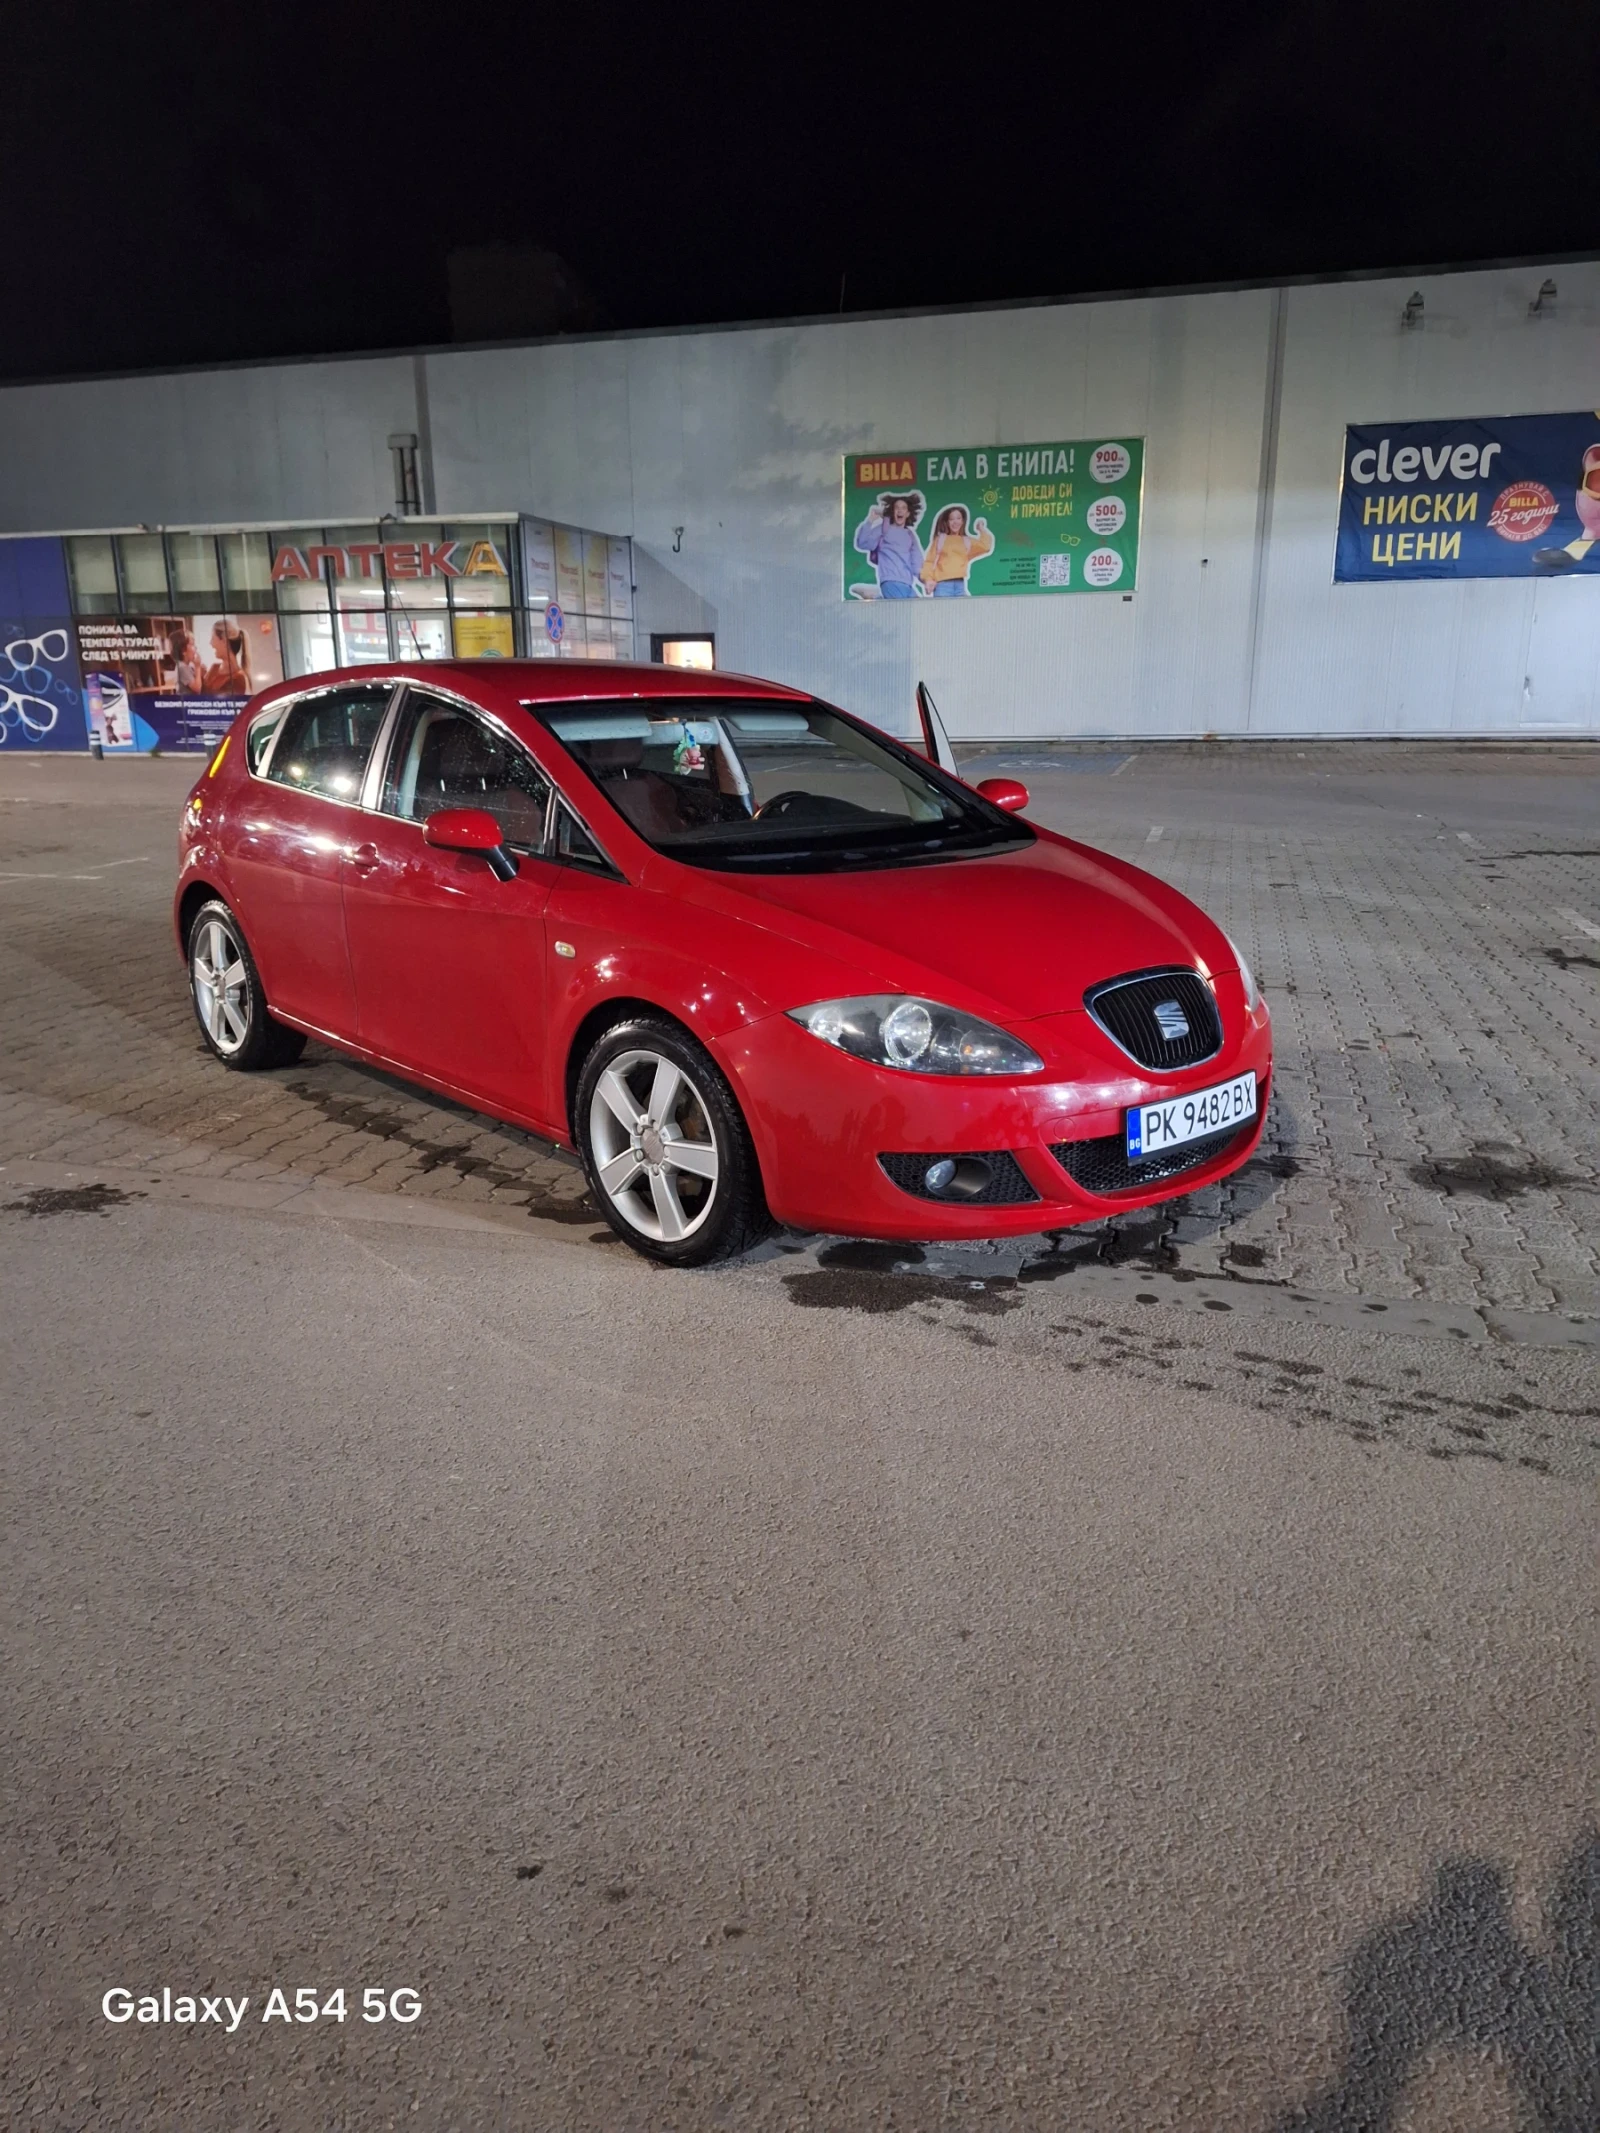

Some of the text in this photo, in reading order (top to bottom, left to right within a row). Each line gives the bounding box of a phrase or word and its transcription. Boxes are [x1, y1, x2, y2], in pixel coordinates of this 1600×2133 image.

[926, 449, 1075, 482] ЕЛА В ЕКИПА!
[1096, 450, 1118, 463] 900
[1350, 439, 1502, 484] clever
[860, 462, 913, 483] BILLA
[1012, 483, 1073, 502] ДОВЕДИ СИ
[1508, 497, 1539, 507] BILLA
[1011, 503, 1073, 519] И ПРИЯТЕЛ!
[1095, 504, 1117, 517] 500
[1363, 492, 1478, 526] НИСКИ
[1486, 504, 1560, 527] 25 години
[1372, 531, 1462, 567] ЦЕНИ
[270, 540, 509, 583] АПТЕКА
[1091, 555, 1112, 567] 200
[82, 650, 165, 662] СЛЕД 15 МИНУТИ
[1146, 1106, 1177, 1147] PK
[1129, 1138, 1141, 1150] BG
